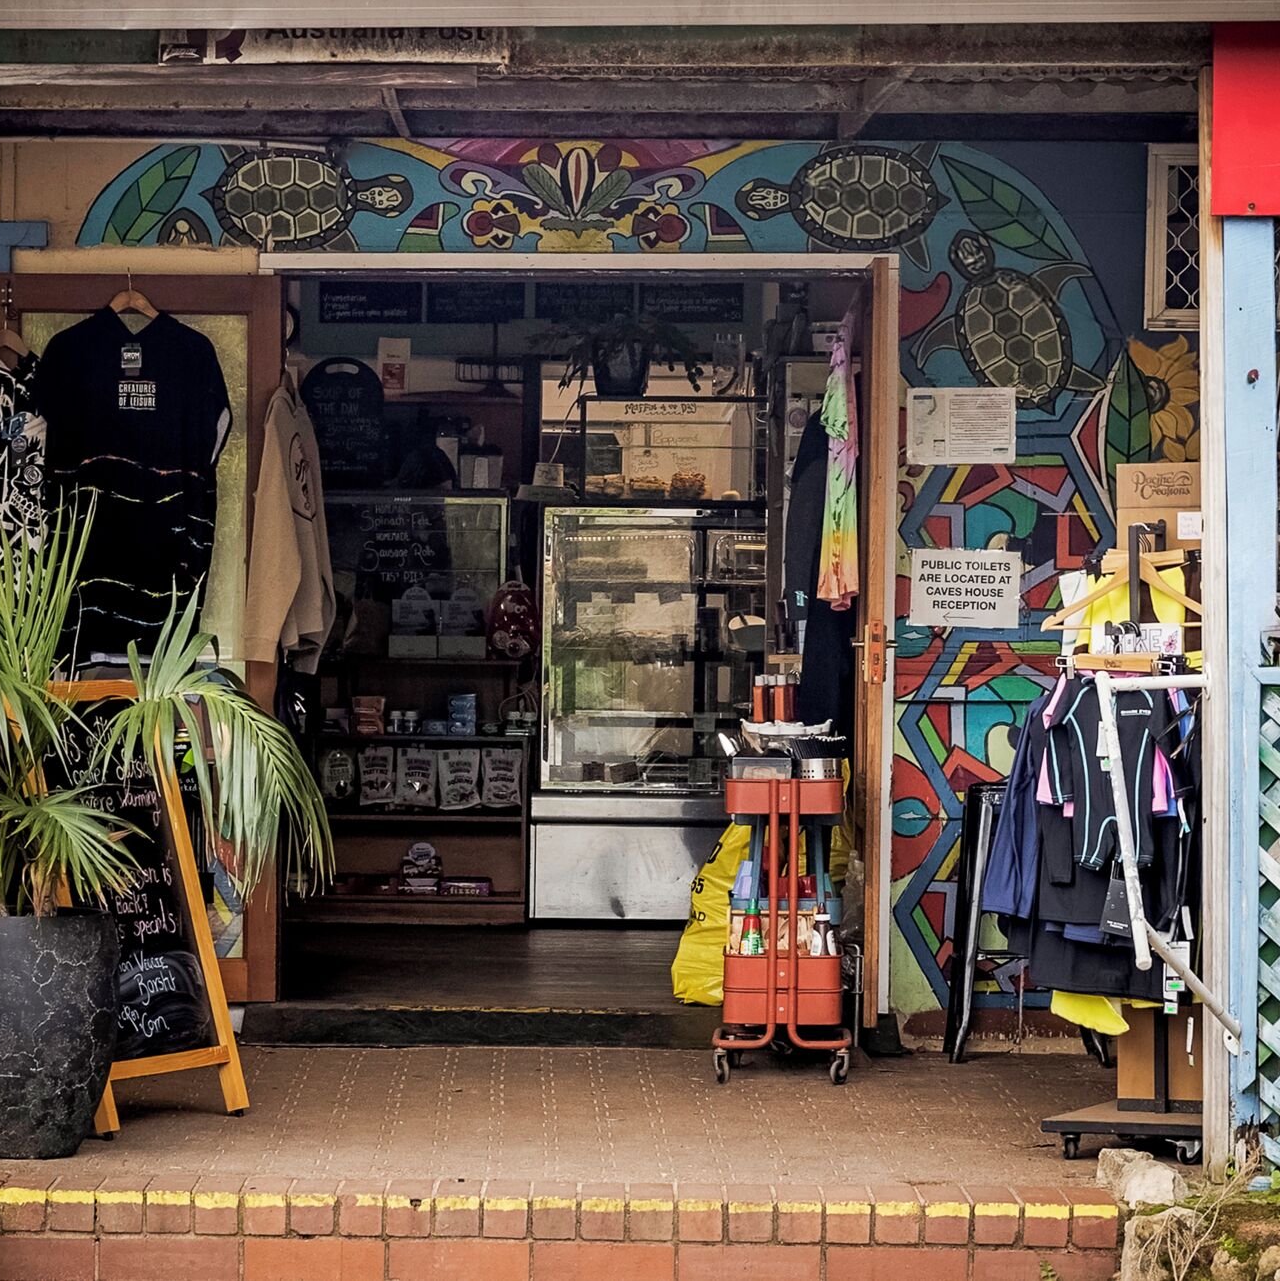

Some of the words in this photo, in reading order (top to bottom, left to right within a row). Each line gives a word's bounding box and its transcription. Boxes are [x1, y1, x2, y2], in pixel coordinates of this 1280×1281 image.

[119, 383, 156, 394] CREATURES
[119, 396, 127, 407] OF
[130, 396, 156, 407] LEISURE
[920, 560, 962, 572] PUBLIC
[964, 561, 1011, 572] TOILETS
[919, 573, 941, 584] ARE
[944, 573, 996, 585] LOCATED
[997, 575, 1012, 586] AT
[926, 586, 962, 598] CAVES
[964, 587, 1004, 598] HOUSE
[932, 599, 997, 611] RECEPTION
[161, 862, 173, 886] is
